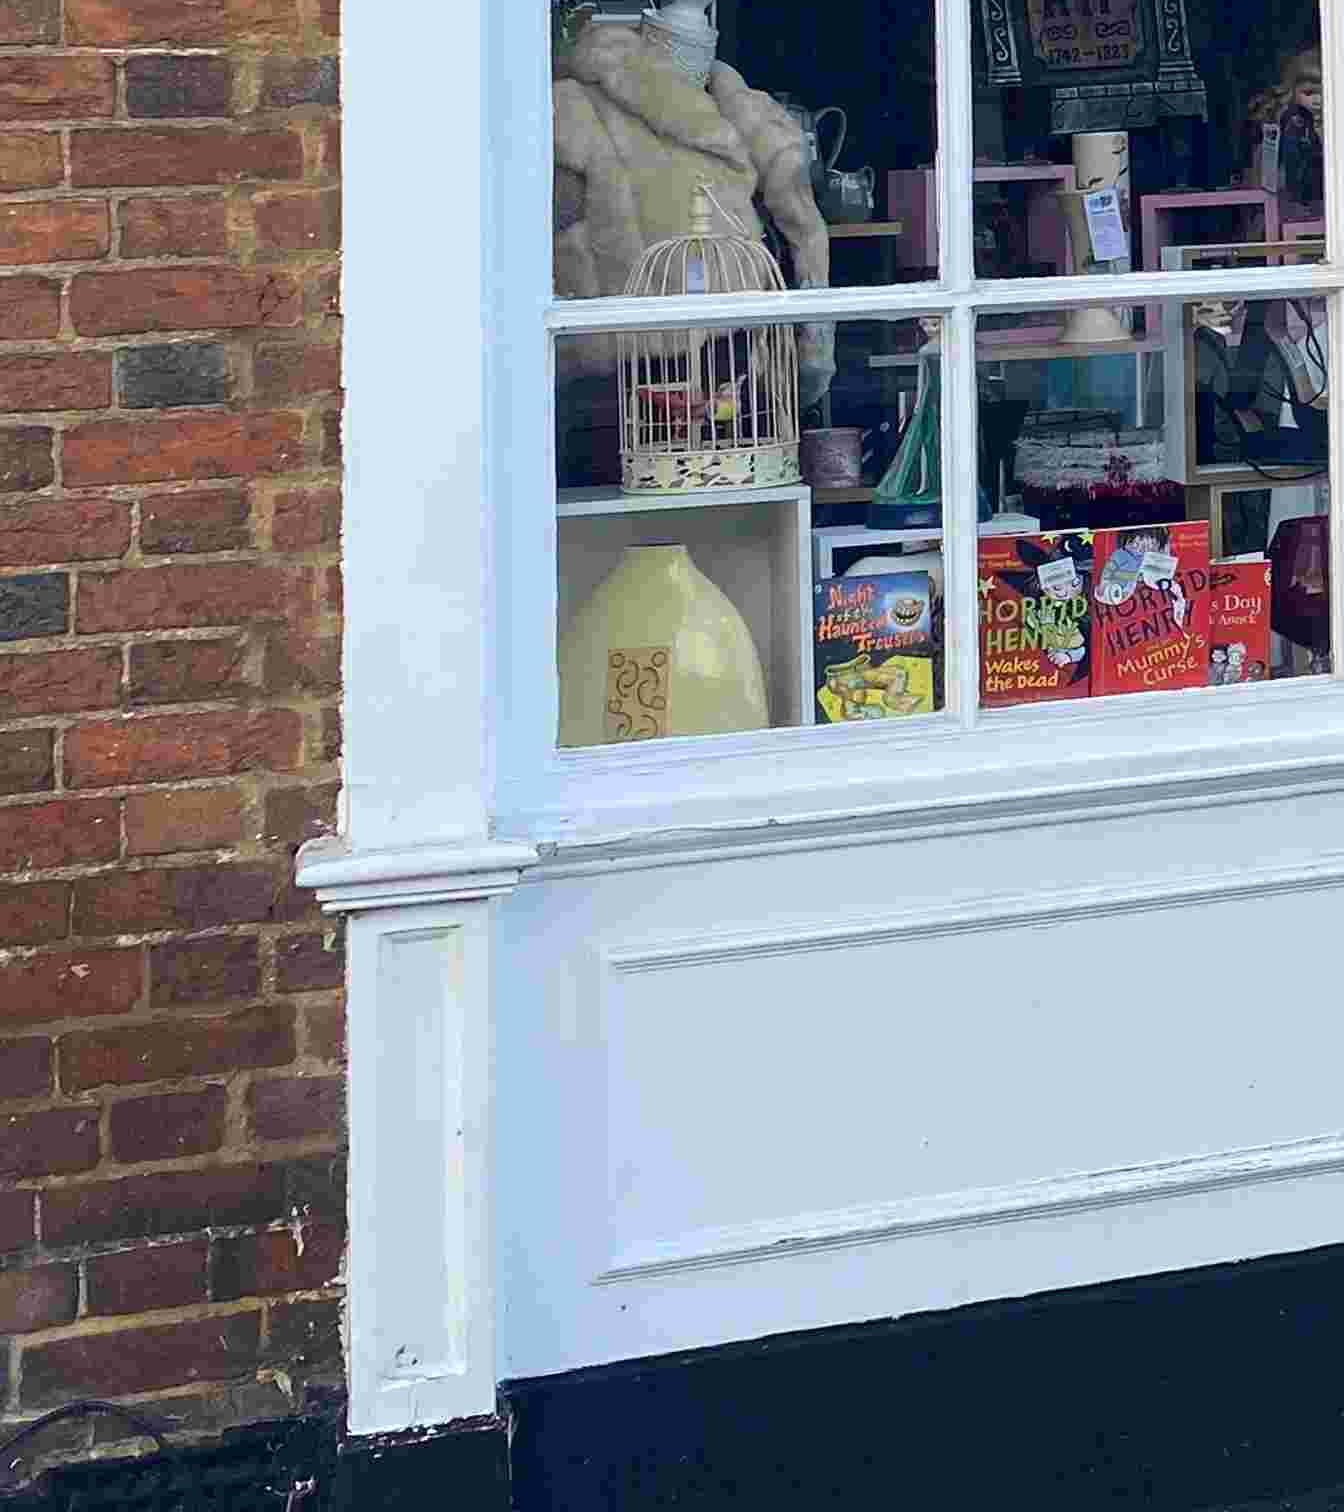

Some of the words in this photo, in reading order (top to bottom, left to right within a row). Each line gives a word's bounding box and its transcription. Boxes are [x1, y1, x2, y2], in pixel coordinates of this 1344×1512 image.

[1223, 593, 1263, 619] Day
[984, 656, 1041, 676] Wakes
[1116, 632, 1208, 679] Mummy's
[984, 672, 1015, 693] the
[1017, 670, 1059, 690] Dead
[1143, 655, 1199, 686] Curse
